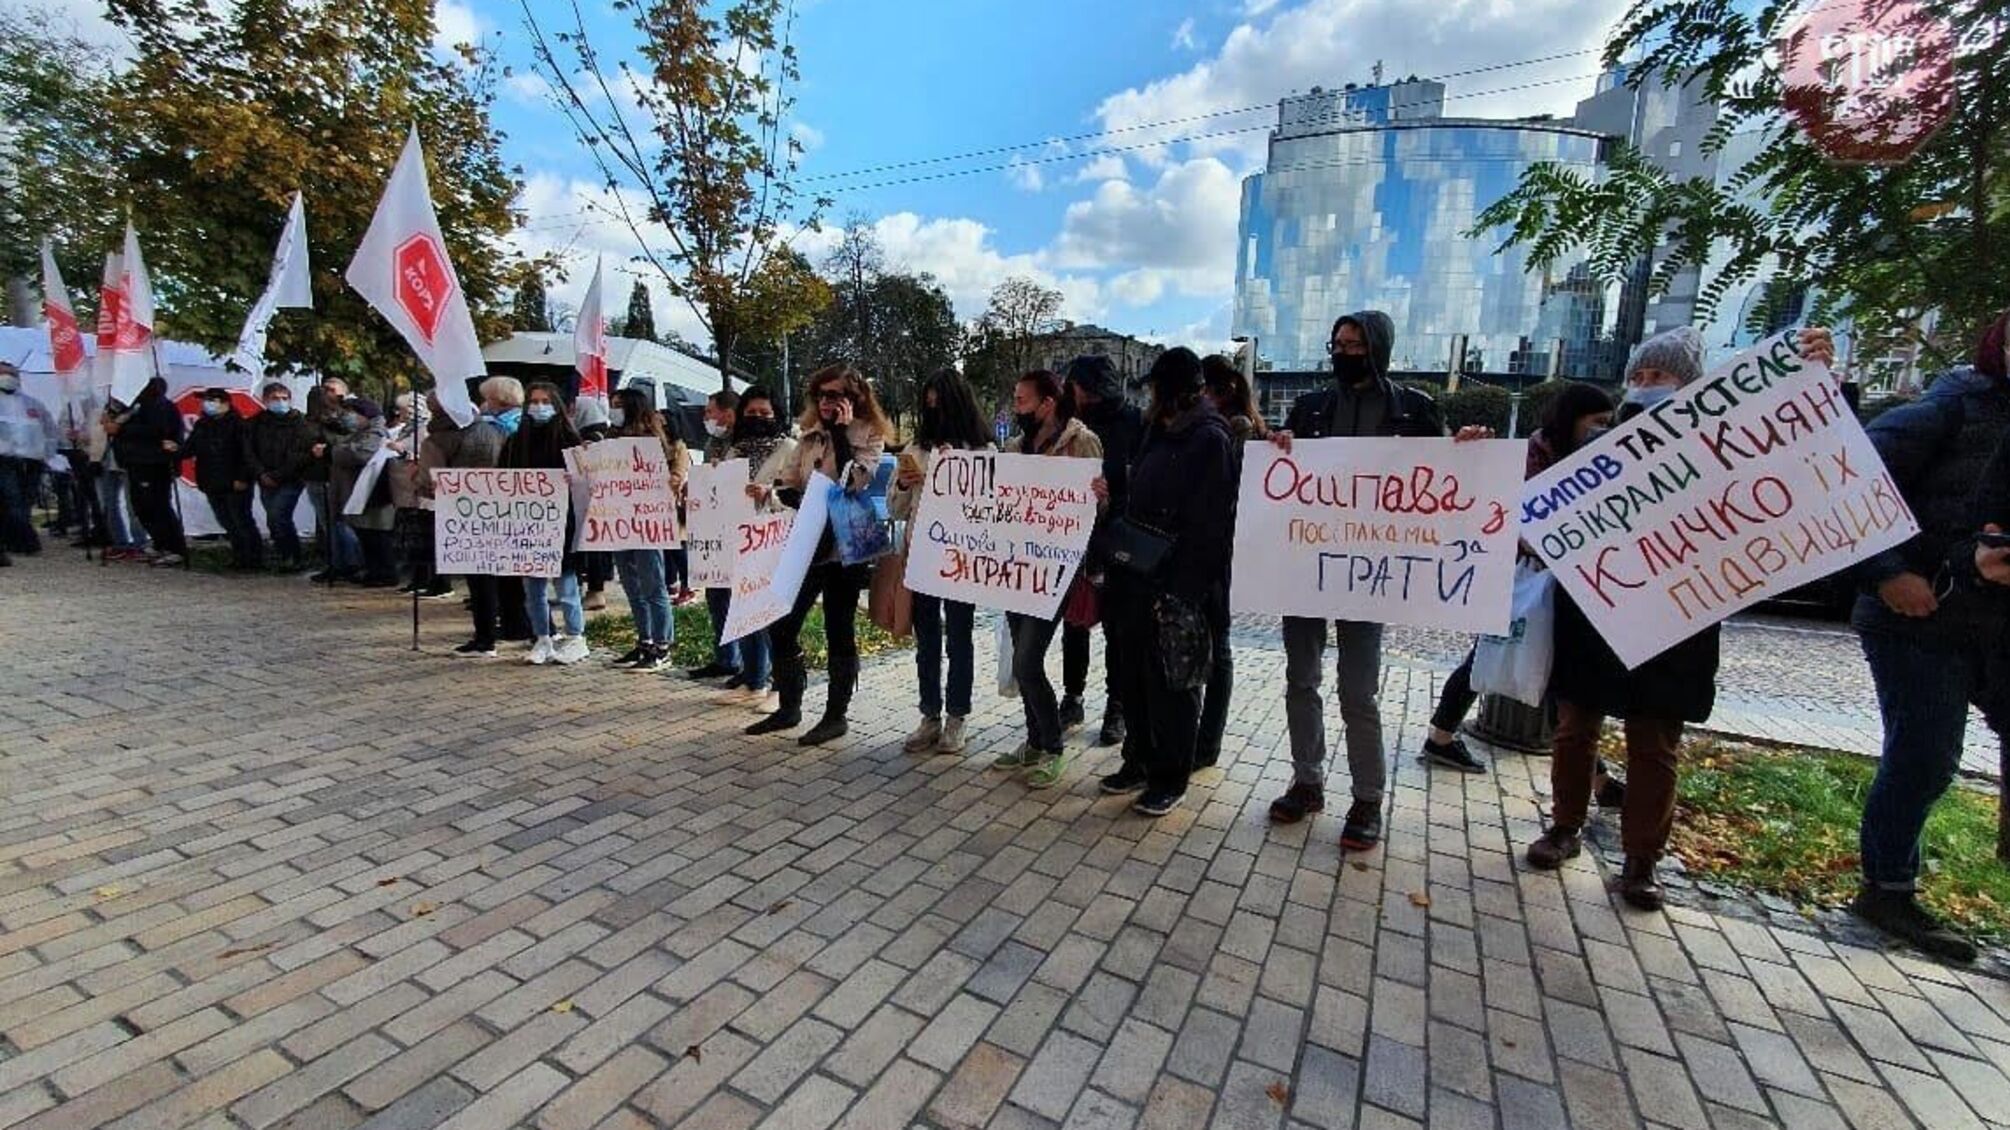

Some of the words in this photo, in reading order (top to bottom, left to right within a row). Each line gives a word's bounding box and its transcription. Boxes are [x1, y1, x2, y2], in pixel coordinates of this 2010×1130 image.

[933, 456, 996, 500] СТОП!
[1541, 452, 1700, 560] ОБІКРАЛИ
[585, 518, 674, 543] ЗЛОЧИН
[1575, 477, 1793, 608] КЛИЧКО
